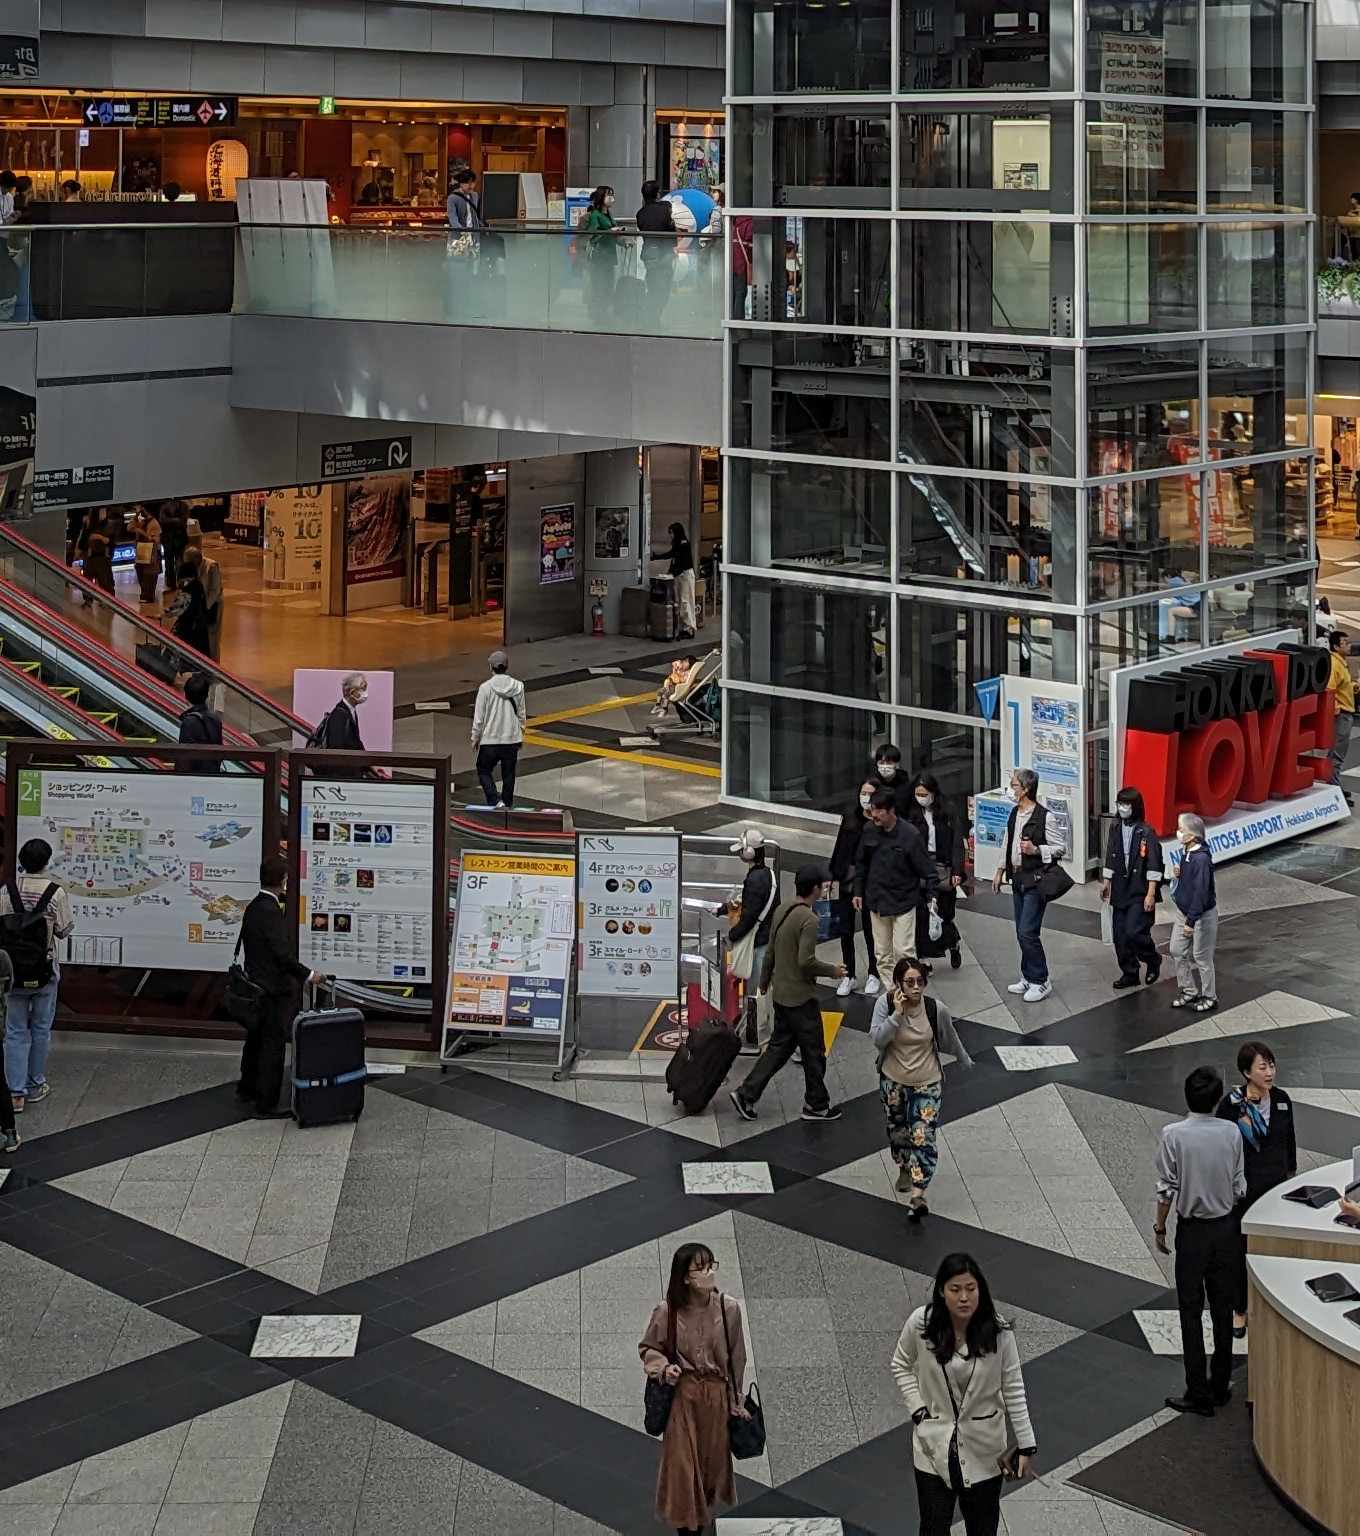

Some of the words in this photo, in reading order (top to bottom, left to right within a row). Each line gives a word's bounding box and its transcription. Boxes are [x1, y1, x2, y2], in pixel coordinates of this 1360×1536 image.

[1128, 642, 1332, 732] HOKKAIDO
[1123, 689, 1337, 838] LOVE!
[21, 781, 41, 801] 2F
[48, 792, 75, 800] Shopping
[1207, 829, 1242, 855] HITOSE
[1242, 815, 1284, 842] AIRPORT
[1286, 810, 1315, 828] Hokkaido
[471, 858, 569, 872] レストラン営業時間のご案内
[589, 862, 603, 873] 4F
[467, 875, 488, 889] 3F
[589, 902, 603, 915] 3F
[589, 944, 603, 957] 3F
